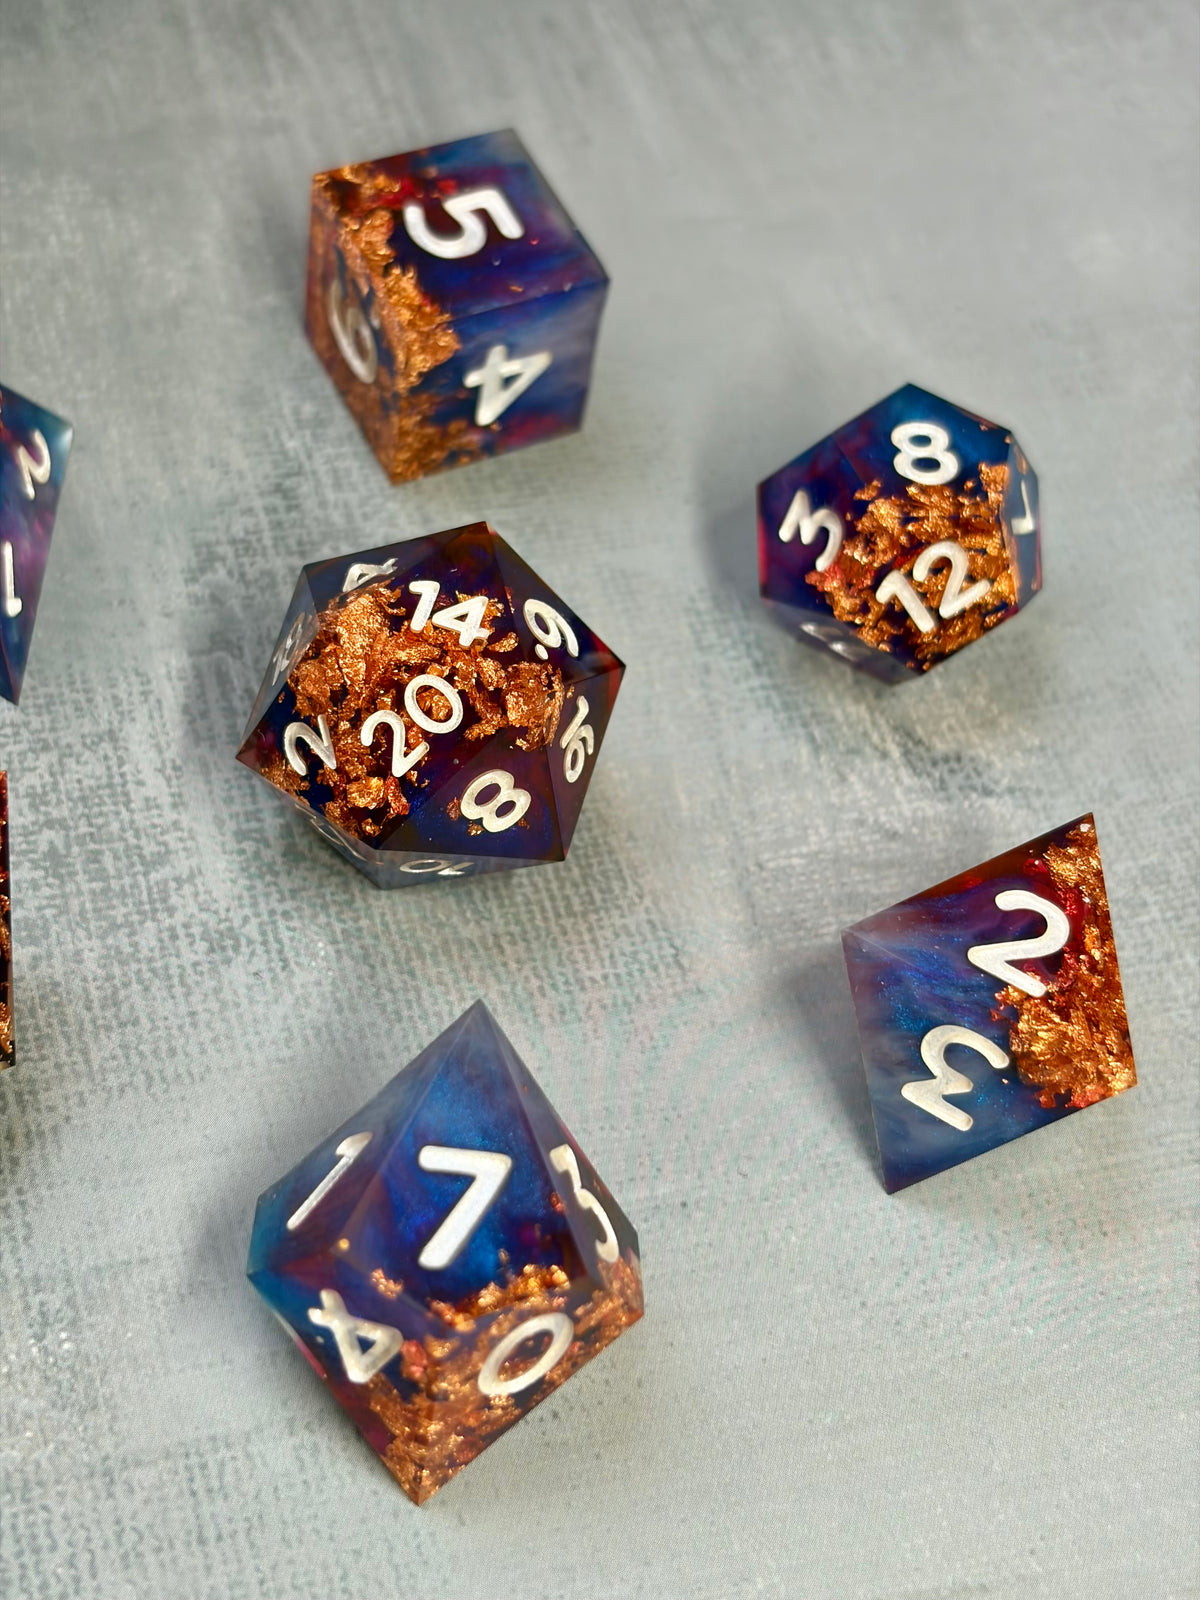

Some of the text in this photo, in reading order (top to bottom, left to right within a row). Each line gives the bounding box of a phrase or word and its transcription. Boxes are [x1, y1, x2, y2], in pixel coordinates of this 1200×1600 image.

[403, 188, 524, 260] 5
[463, 344, 552, 427] 4
[17, 428, 51, 500] 2
[890, 421, 959, 486] 8
[778, 489, 843, 573] 3
[342, 557, 399, 594] 4
[409, 579, 490, 649] 14
[875, 540, 992, 634] 12
[283, 714, 337, 777] 2
[361, 673, 464, 779] 20
[559, 695, 595, 784] 16
[460, 768, 532, 834] 8
[966, 889, 1071, 998] 2
[900, 1024, 1010, 1132] 3
[286, 1131, 373, 1231] 1
[417, 1145, 513, 1271] 7
[549, 1144, 620, 1265] 3
[307, 1289, 403, 1384] 4
[476, 1312, 575, 1397] 0
